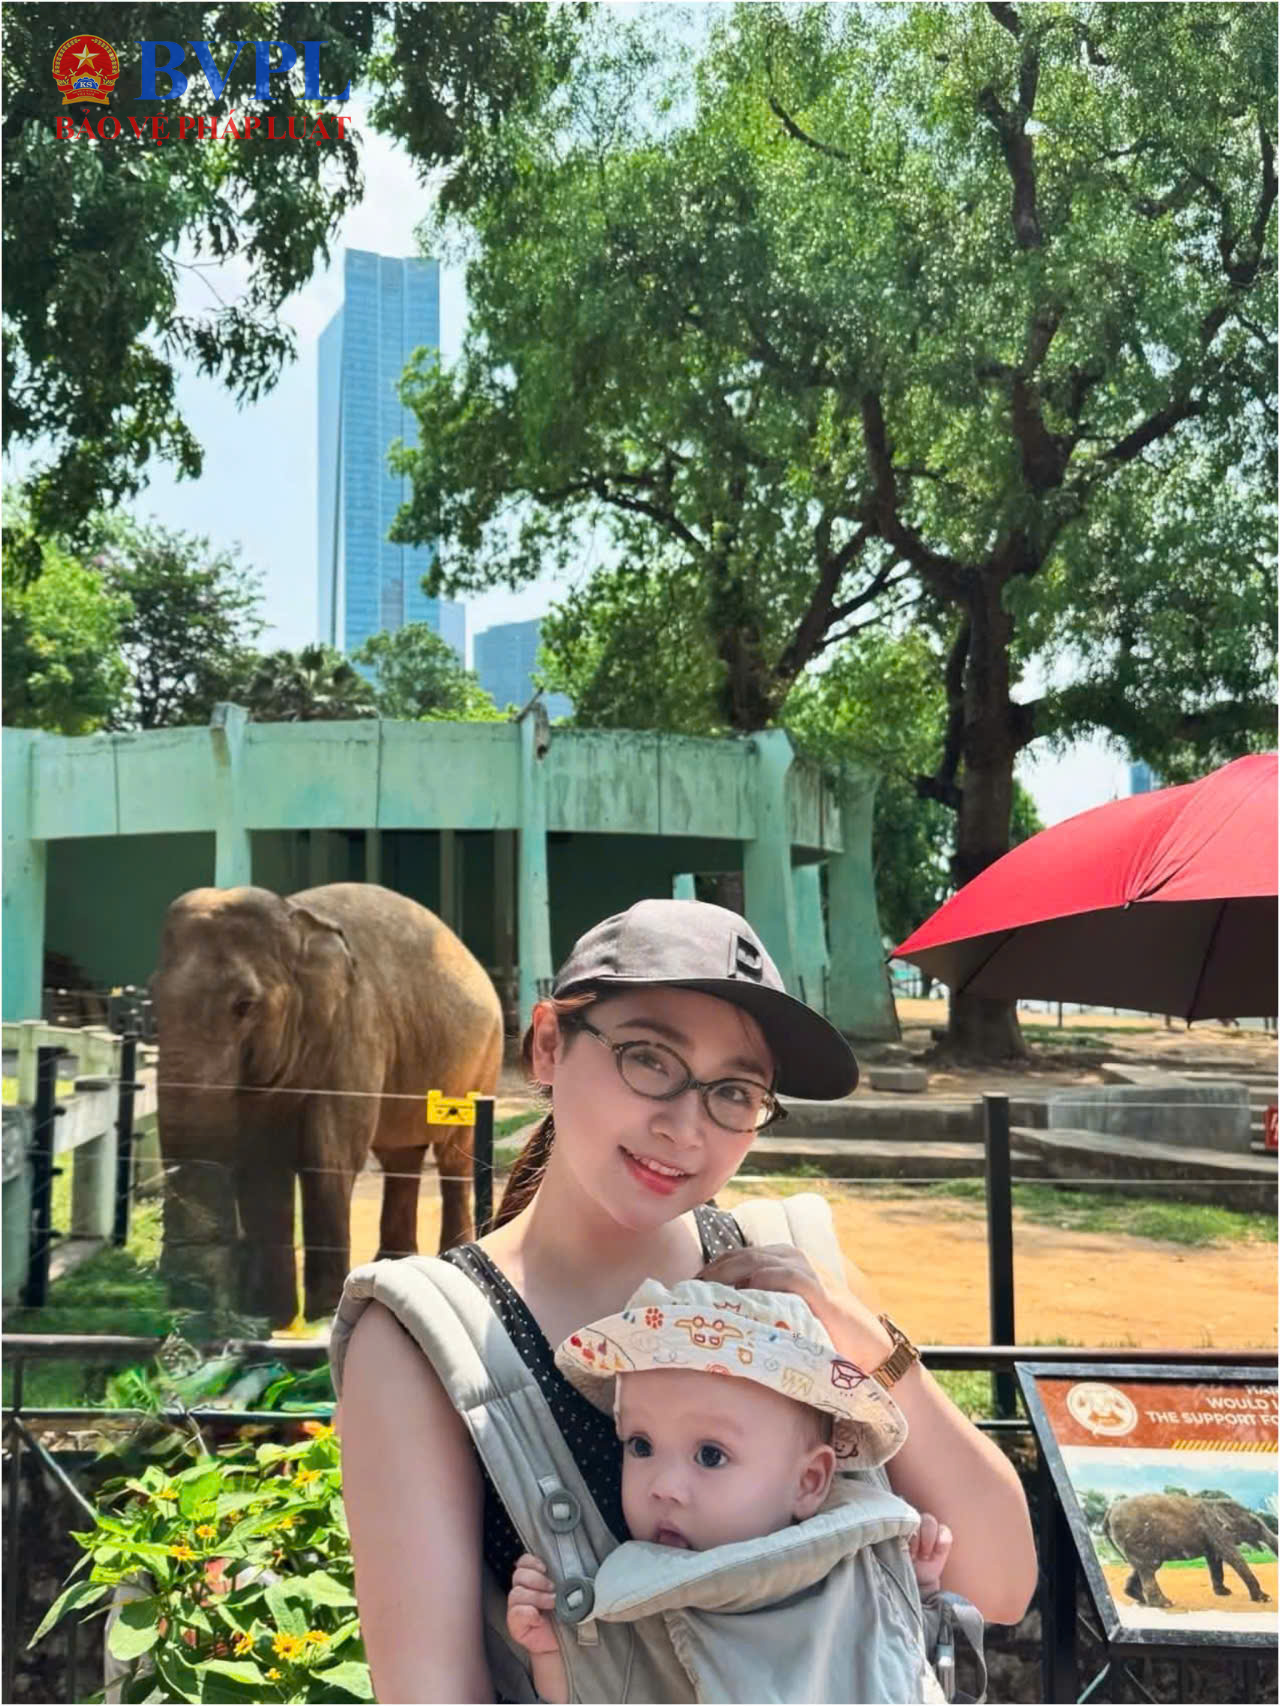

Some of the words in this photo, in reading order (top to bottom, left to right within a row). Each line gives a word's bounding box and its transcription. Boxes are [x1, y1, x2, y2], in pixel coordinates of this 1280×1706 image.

[1206, 1397, 1269, 1410] WOULD
[1144, 1411, 1179, 1423] THE
[1181, 1411, 1256, 1425] SUPPORT
